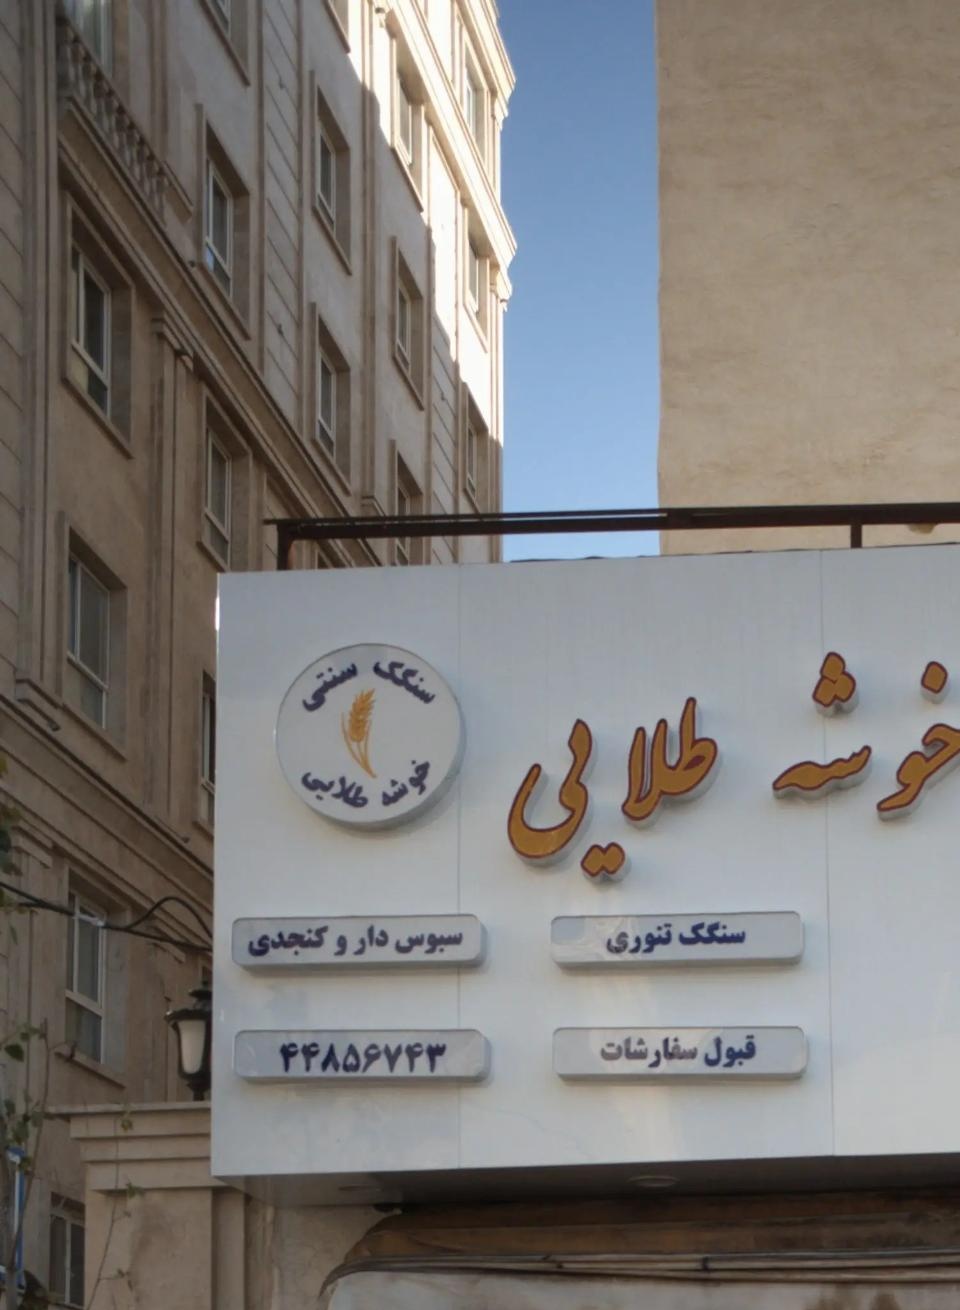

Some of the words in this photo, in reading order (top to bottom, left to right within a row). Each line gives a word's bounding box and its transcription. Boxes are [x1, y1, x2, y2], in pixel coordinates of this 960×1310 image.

[302, 663, 358, 712] سنتی
[372, 661, 436, 704] سنگک
[301, 771, 369, 809] طلایی
[381, 760, 431, 807] خوشه
[507, 699, 717, 877] طلایی
[247, 925, 329, 957] کنجدی
[334, 934, 348, 956] و
[354, 925, 389, 956] دار
[395, 932, 463, 954] سبوس
[606, 923, 673, 954] تنوری
[678, 922, 746, 946] سنگک
[279, 1042, 447, 1073] ۴۴۸۵۶۷۴۳
[600, 1037, 698, 1068] سفارشات
[704, 1035, 756, 1068] قبول
